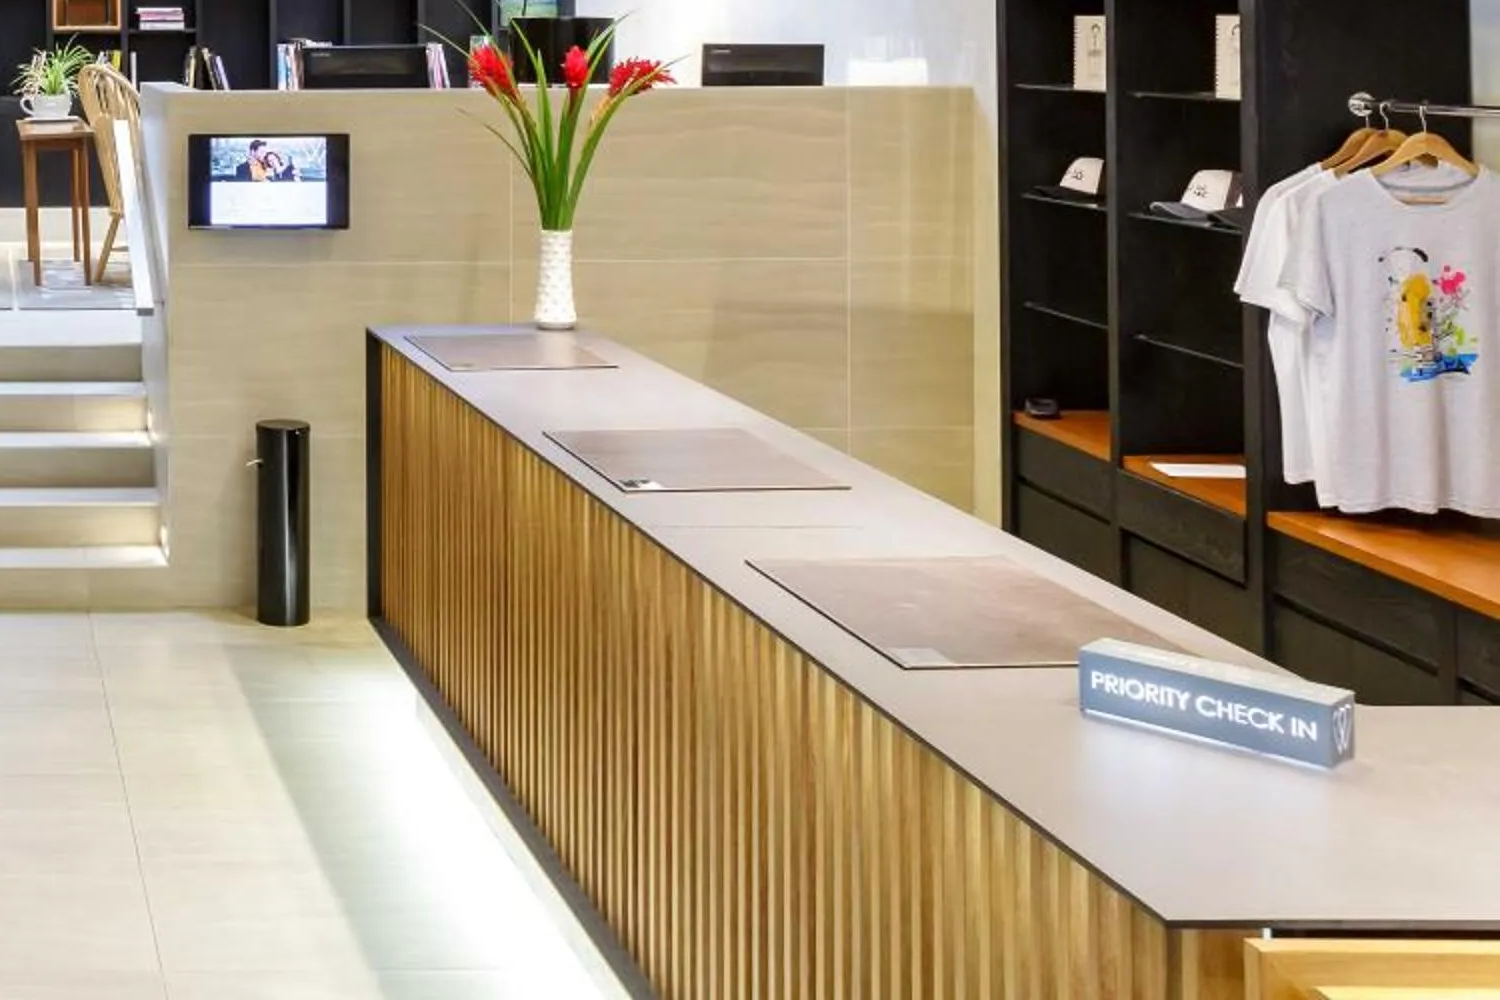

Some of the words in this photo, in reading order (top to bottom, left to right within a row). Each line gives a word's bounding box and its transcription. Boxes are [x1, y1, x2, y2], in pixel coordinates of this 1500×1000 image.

[1091, 670, 1191, 711] PRIORITY
[1195, 695, 1285, 734] CHECK
[1291, 716, 1318, 741] IN
